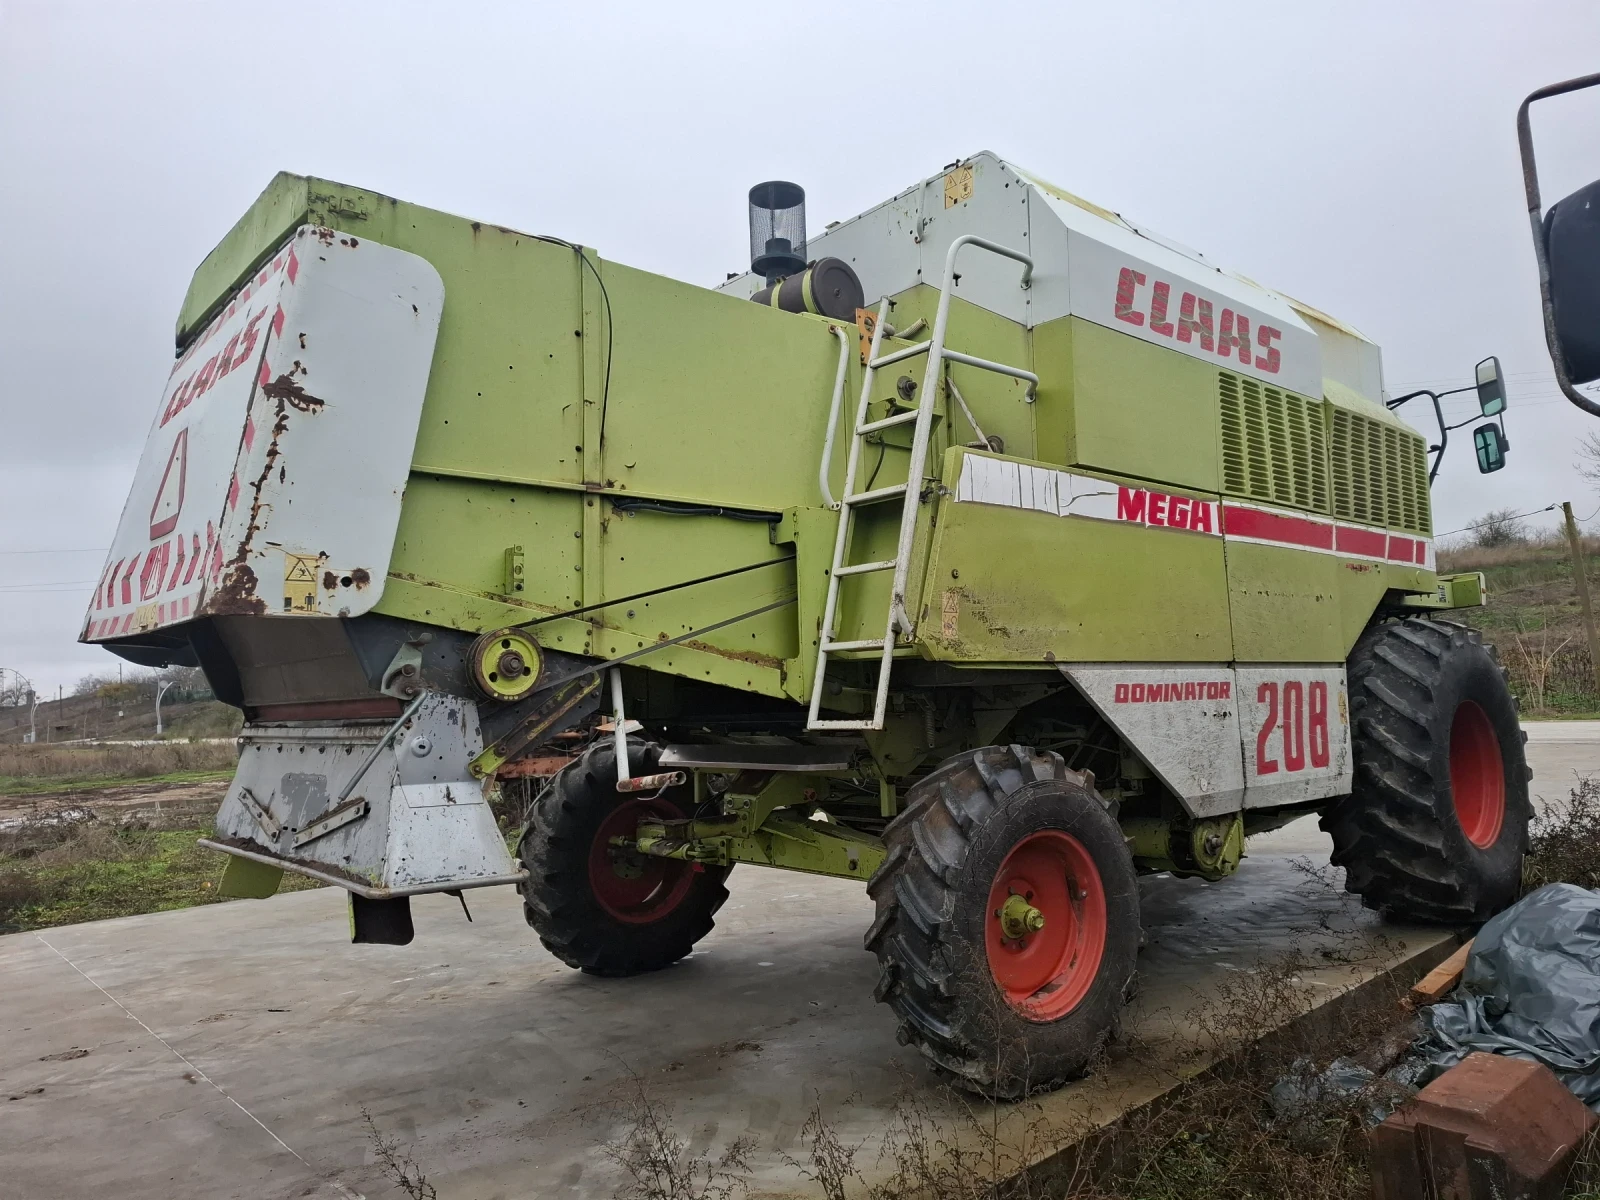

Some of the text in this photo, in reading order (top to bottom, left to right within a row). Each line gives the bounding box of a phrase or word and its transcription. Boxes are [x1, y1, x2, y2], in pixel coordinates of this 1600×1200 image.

[159, 304, 269, 429] CLAAS
[1114, 266, 1282, 374] CLAAS
[1117, 486, 1213, 533] MEGA
[1114, 681, 1231, 703] DOMINATOR
[1257, 680, 1330, 775] 208
